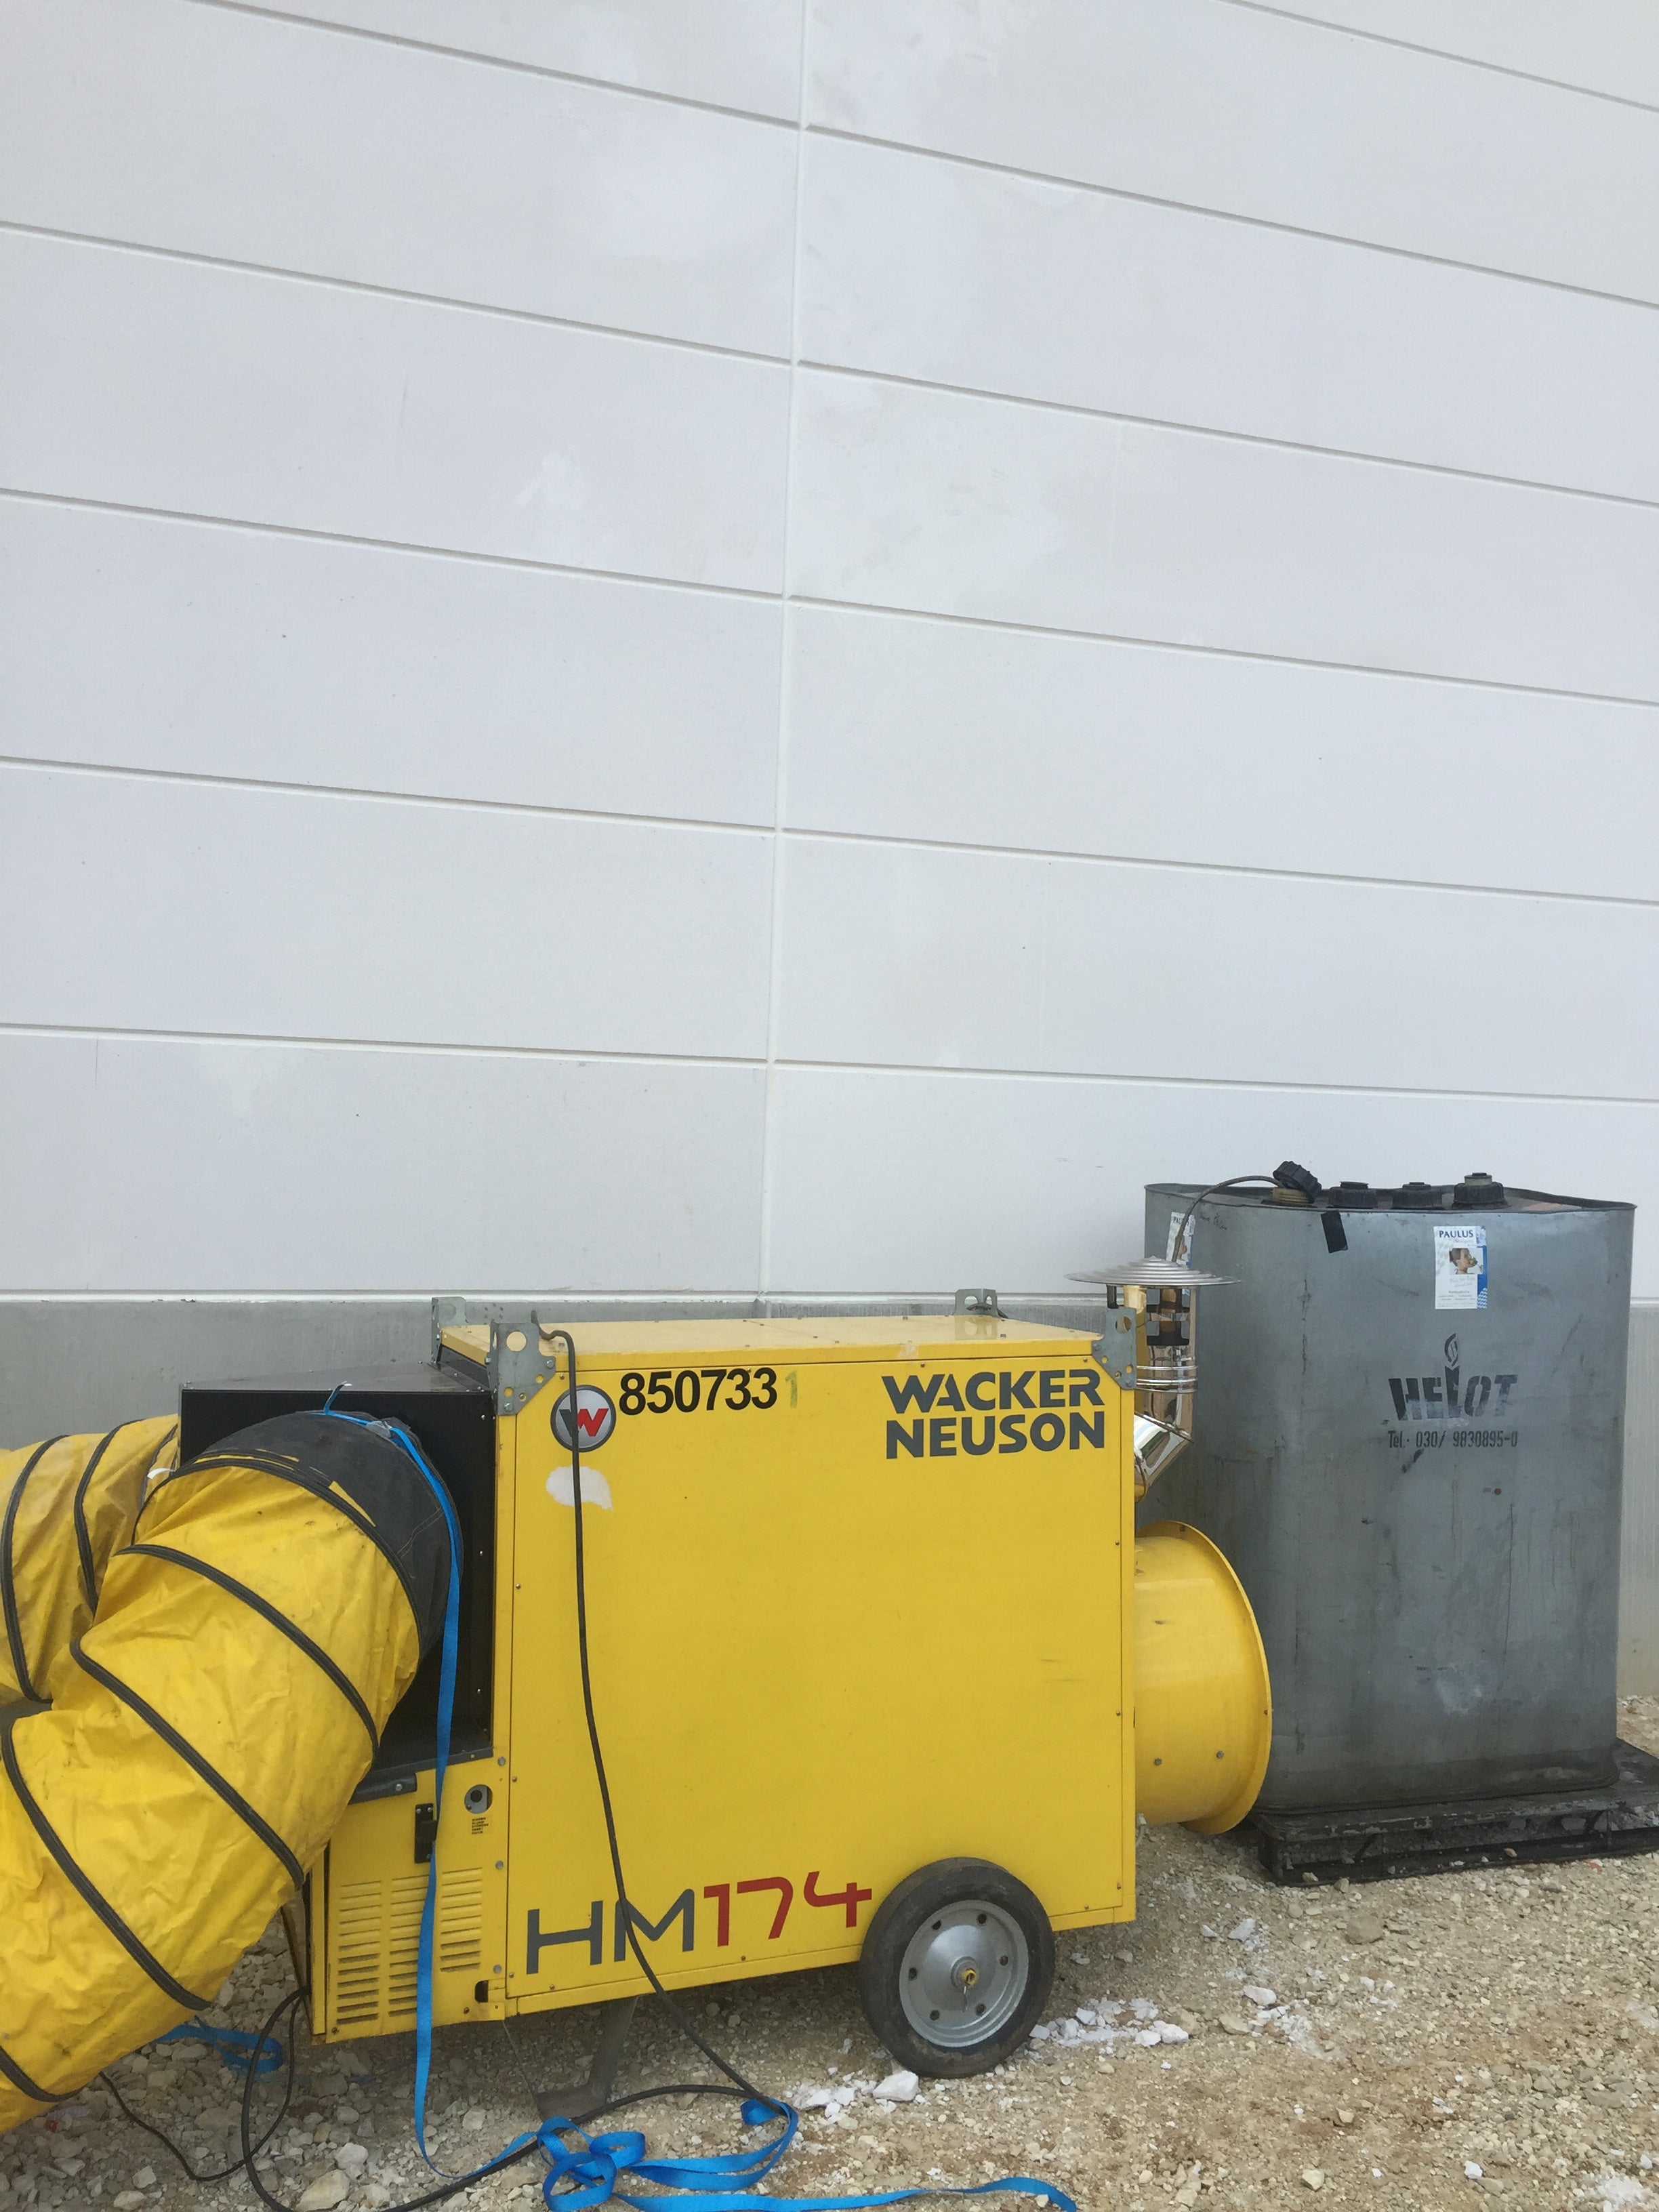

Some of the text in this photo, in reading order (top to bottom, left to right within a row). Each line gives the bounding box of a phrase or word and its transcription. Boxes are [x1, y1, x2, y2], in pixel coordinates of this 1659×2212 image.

[1439, 1229, 1474, 1238] PAULUS
[619, 1367, 778, 1416] 850733
[881, 1368, 1105, 1414] WACKER
[1388, 1365, 1518, 1420] HELOT
[886, 1410, 1105, 1459] NEUSON
[1453, 1431, 1518, 1448] 9830895-0
[526, 1870, 872, 1975] HM174
